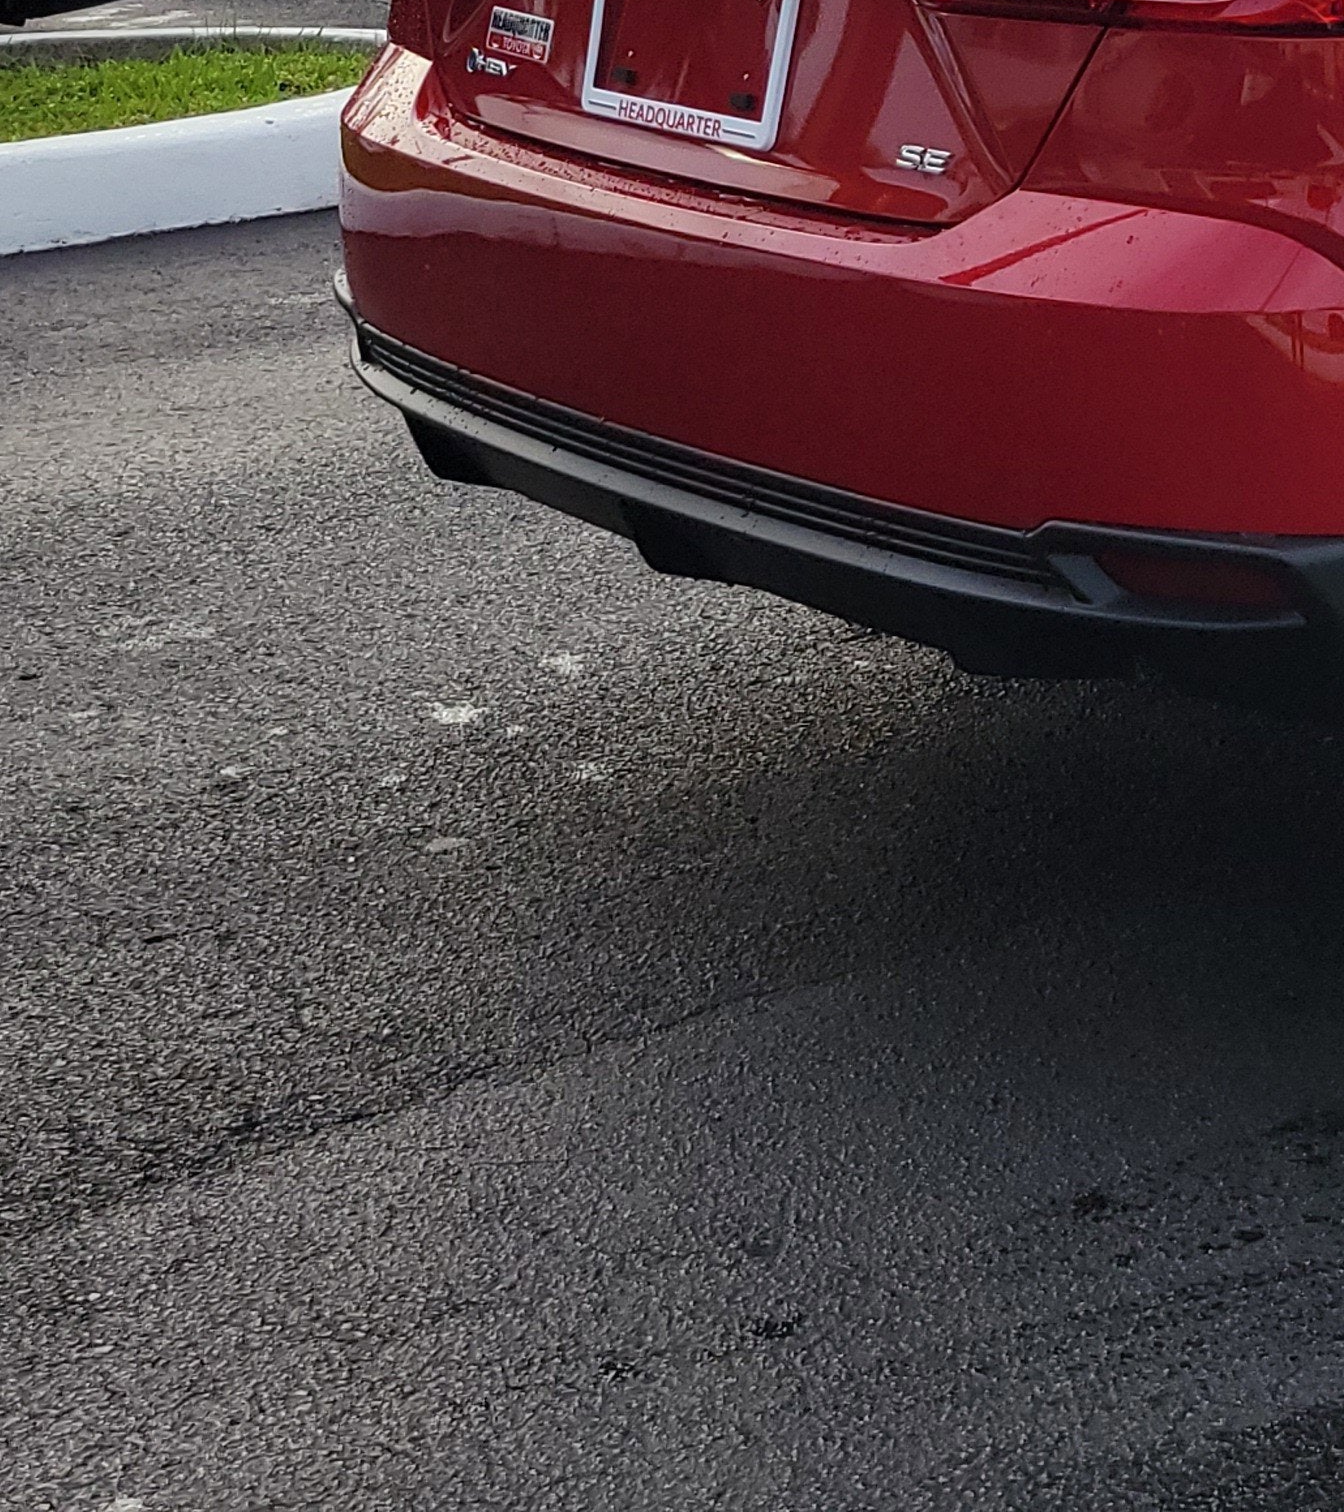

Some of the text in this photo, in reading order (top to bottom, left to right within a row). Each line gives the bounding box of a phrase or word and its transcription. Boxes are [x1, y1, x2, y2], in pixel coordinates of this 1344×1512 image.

[503, 36, 531, 56] TOYOTA
[618, 98, 722, 138] HEADQUARTER
[896, 144, 952, 175] SE
